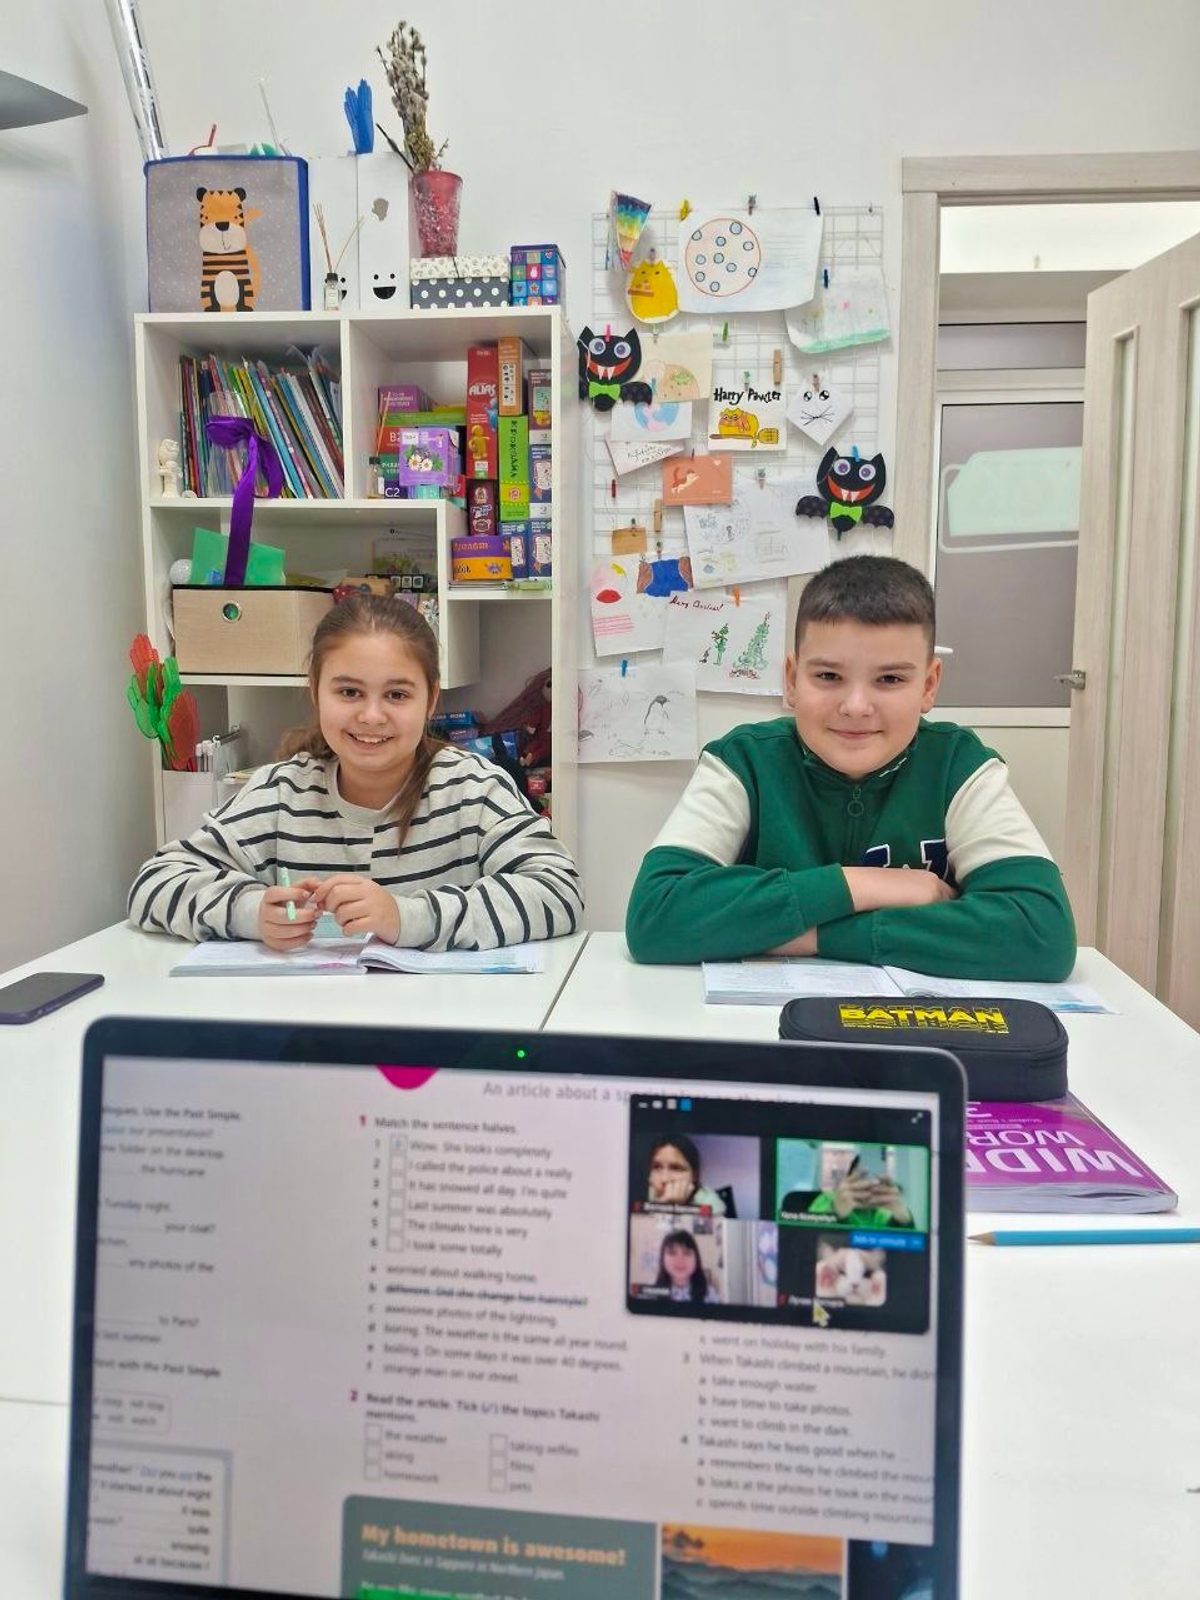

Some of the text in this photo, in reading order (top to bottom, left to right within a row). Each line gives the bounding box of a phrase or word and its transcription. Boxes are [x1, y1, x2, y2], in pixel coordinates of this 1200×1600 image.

[714, 386, 744, 406] Harry
[385, 487, 400, 498] C2
[839, 1005, 1007, 1028] BATMAN
[483, 1082, 502, 1096] An
[507, 1083, 550, 1099] article
[556, 1085, 597, 1100] about
[602, 1089, 611, 1100] a
[375, 1117, 516, 1134] Match the sentence halves.
[361, 1523, 625, 1566] My hometown is awesome!
